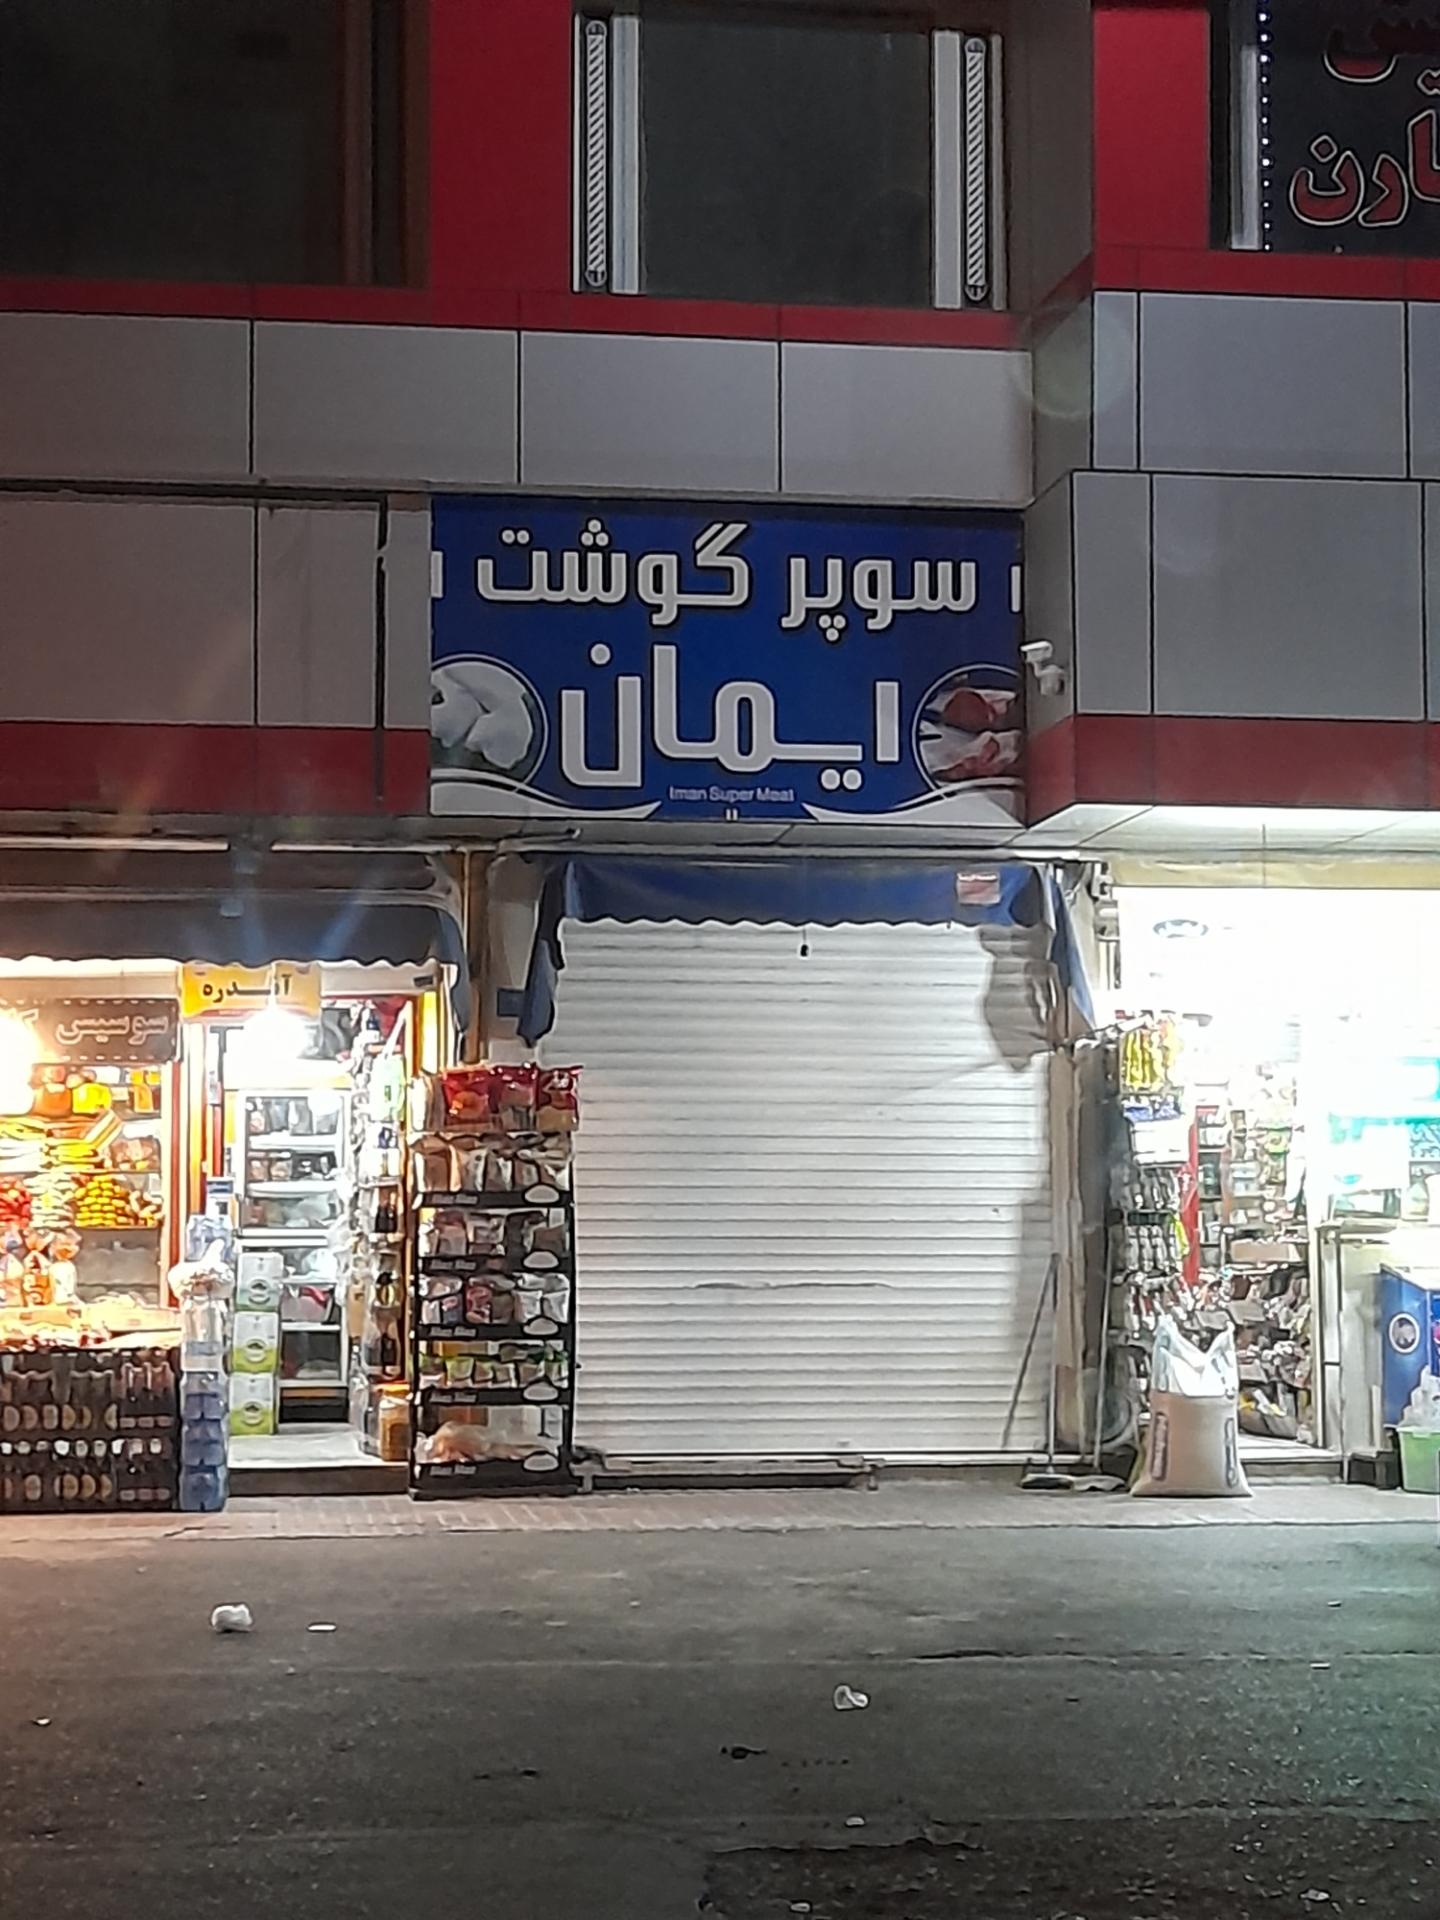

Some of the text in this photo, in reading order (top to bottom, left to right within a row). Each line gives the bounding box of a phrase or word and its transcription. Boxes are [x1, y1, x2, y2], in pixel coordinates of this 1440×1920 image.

[1289, 109, 1440, 227] ارن
[476, 518, 976, 642] سوپر گوشت
[560, 643, 900, 791] ایمان
[669, 785, 795, 803] Iman Super Meat
[55, 1013, 170, 1046] سوسیس
